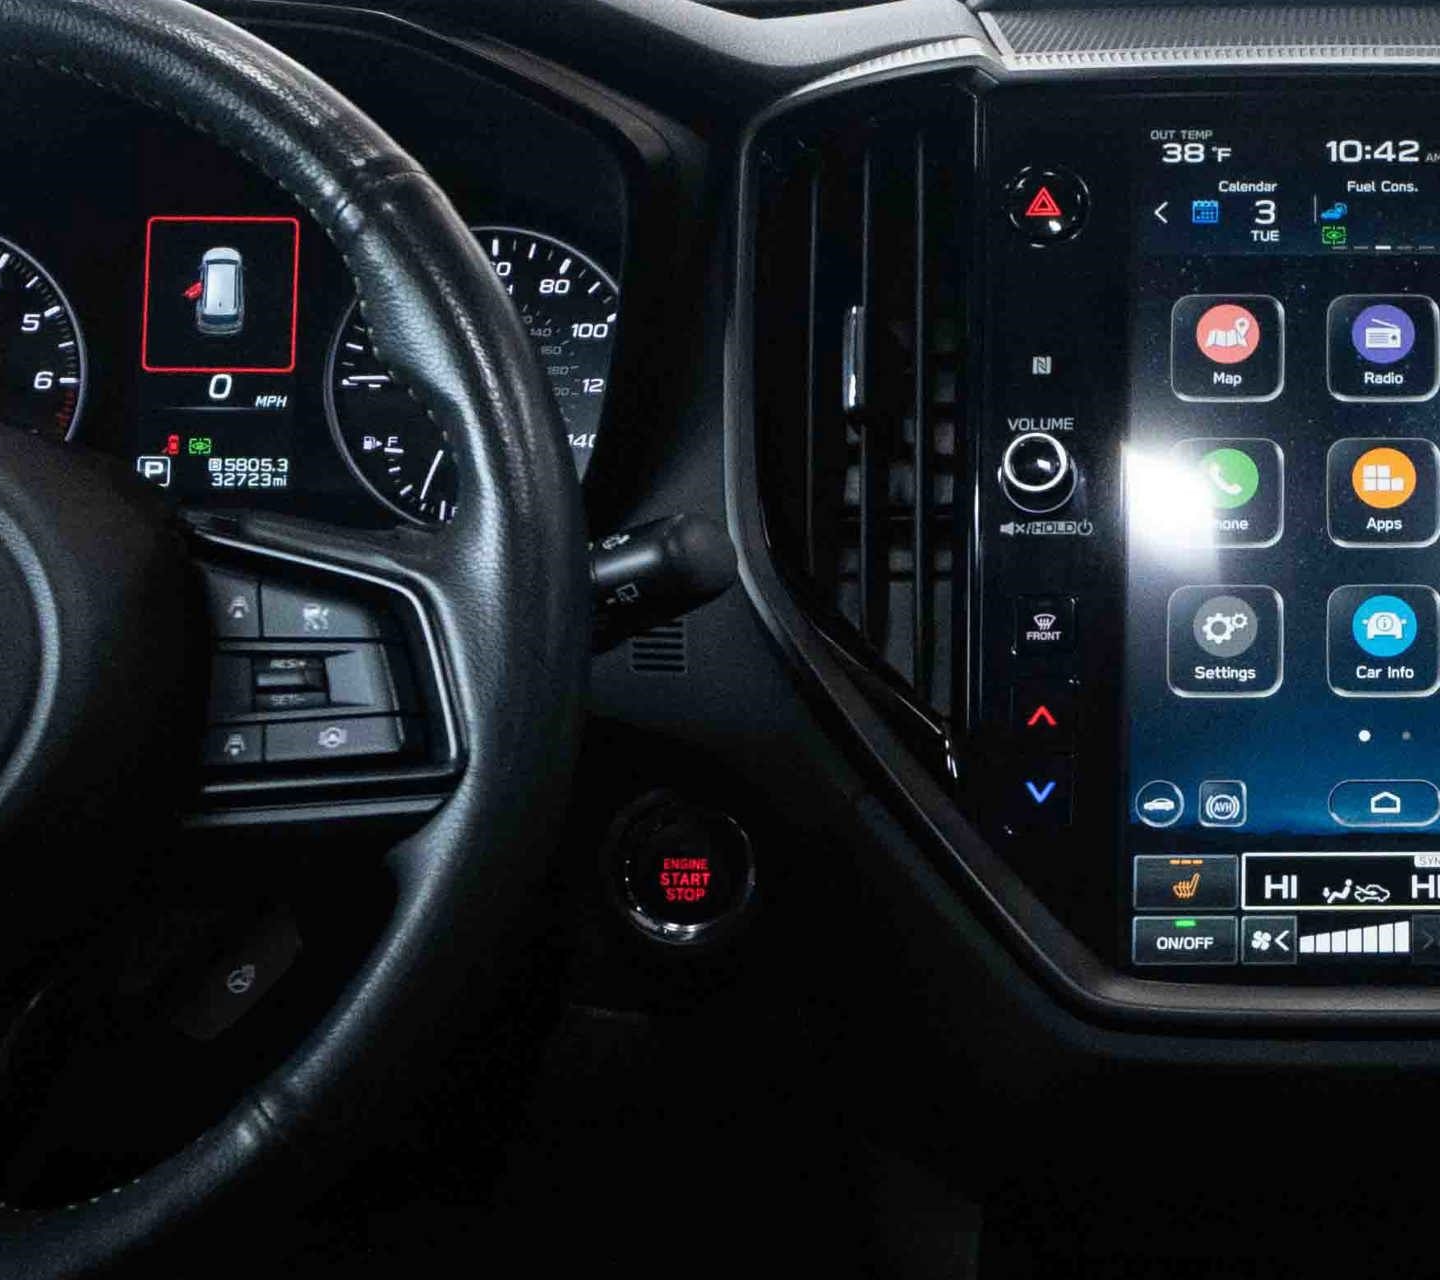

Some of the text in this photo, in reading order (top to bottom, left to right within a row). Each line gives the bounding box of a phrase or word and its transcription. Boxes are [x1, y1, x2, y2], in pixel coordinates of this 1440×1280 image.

[1150, 129, 1213, 141] OUT TEMP
[1162, 142, 1205, 164] 38
[1325, 139, 1420, 163] 10:42
[1218, 180, 1278, 193] Calendar
[1347, 180, 1419, 193] Fuel Cons.
[1254, 199, 1276, 225] 3
[1250, 229, 1280, 242] TUE
[538, 278, 571, 295] 80
[20, 313, 41, 332] 5
[571, 322, 609, 339] 100
[33, 370, 54, 390] 6
[208, 373, 233, 400] 0
[580, 376, 608, 394] 12
[1212, 371, 1243, 388] Map
[1364, 371, 1404, 385] Radio
[254, 395, 288, 408] MPH
[1007, 417, 1075, 432] VOLUME
[387, 435, 399, 448] F
[144, 461, 164, 479] P
[223, 457, 289, 475] 5805.3
[1365, 516, 1403, 533] Apps
[1026, 628, 1062, 641] FRONT
[1194, 665, 1257, 683] Settings
[1355, 665, 1415, 679] Car Info
[1213, 799, 1233, 816] AVH
[662, 857, 710, 870] ENGINE
[659, 872, 711, 886] START
[1264, 874, 1298, 900] HI
[665, 887, 706, 902] STOP
[1156, 936, 1214, 950] ON/OFF
